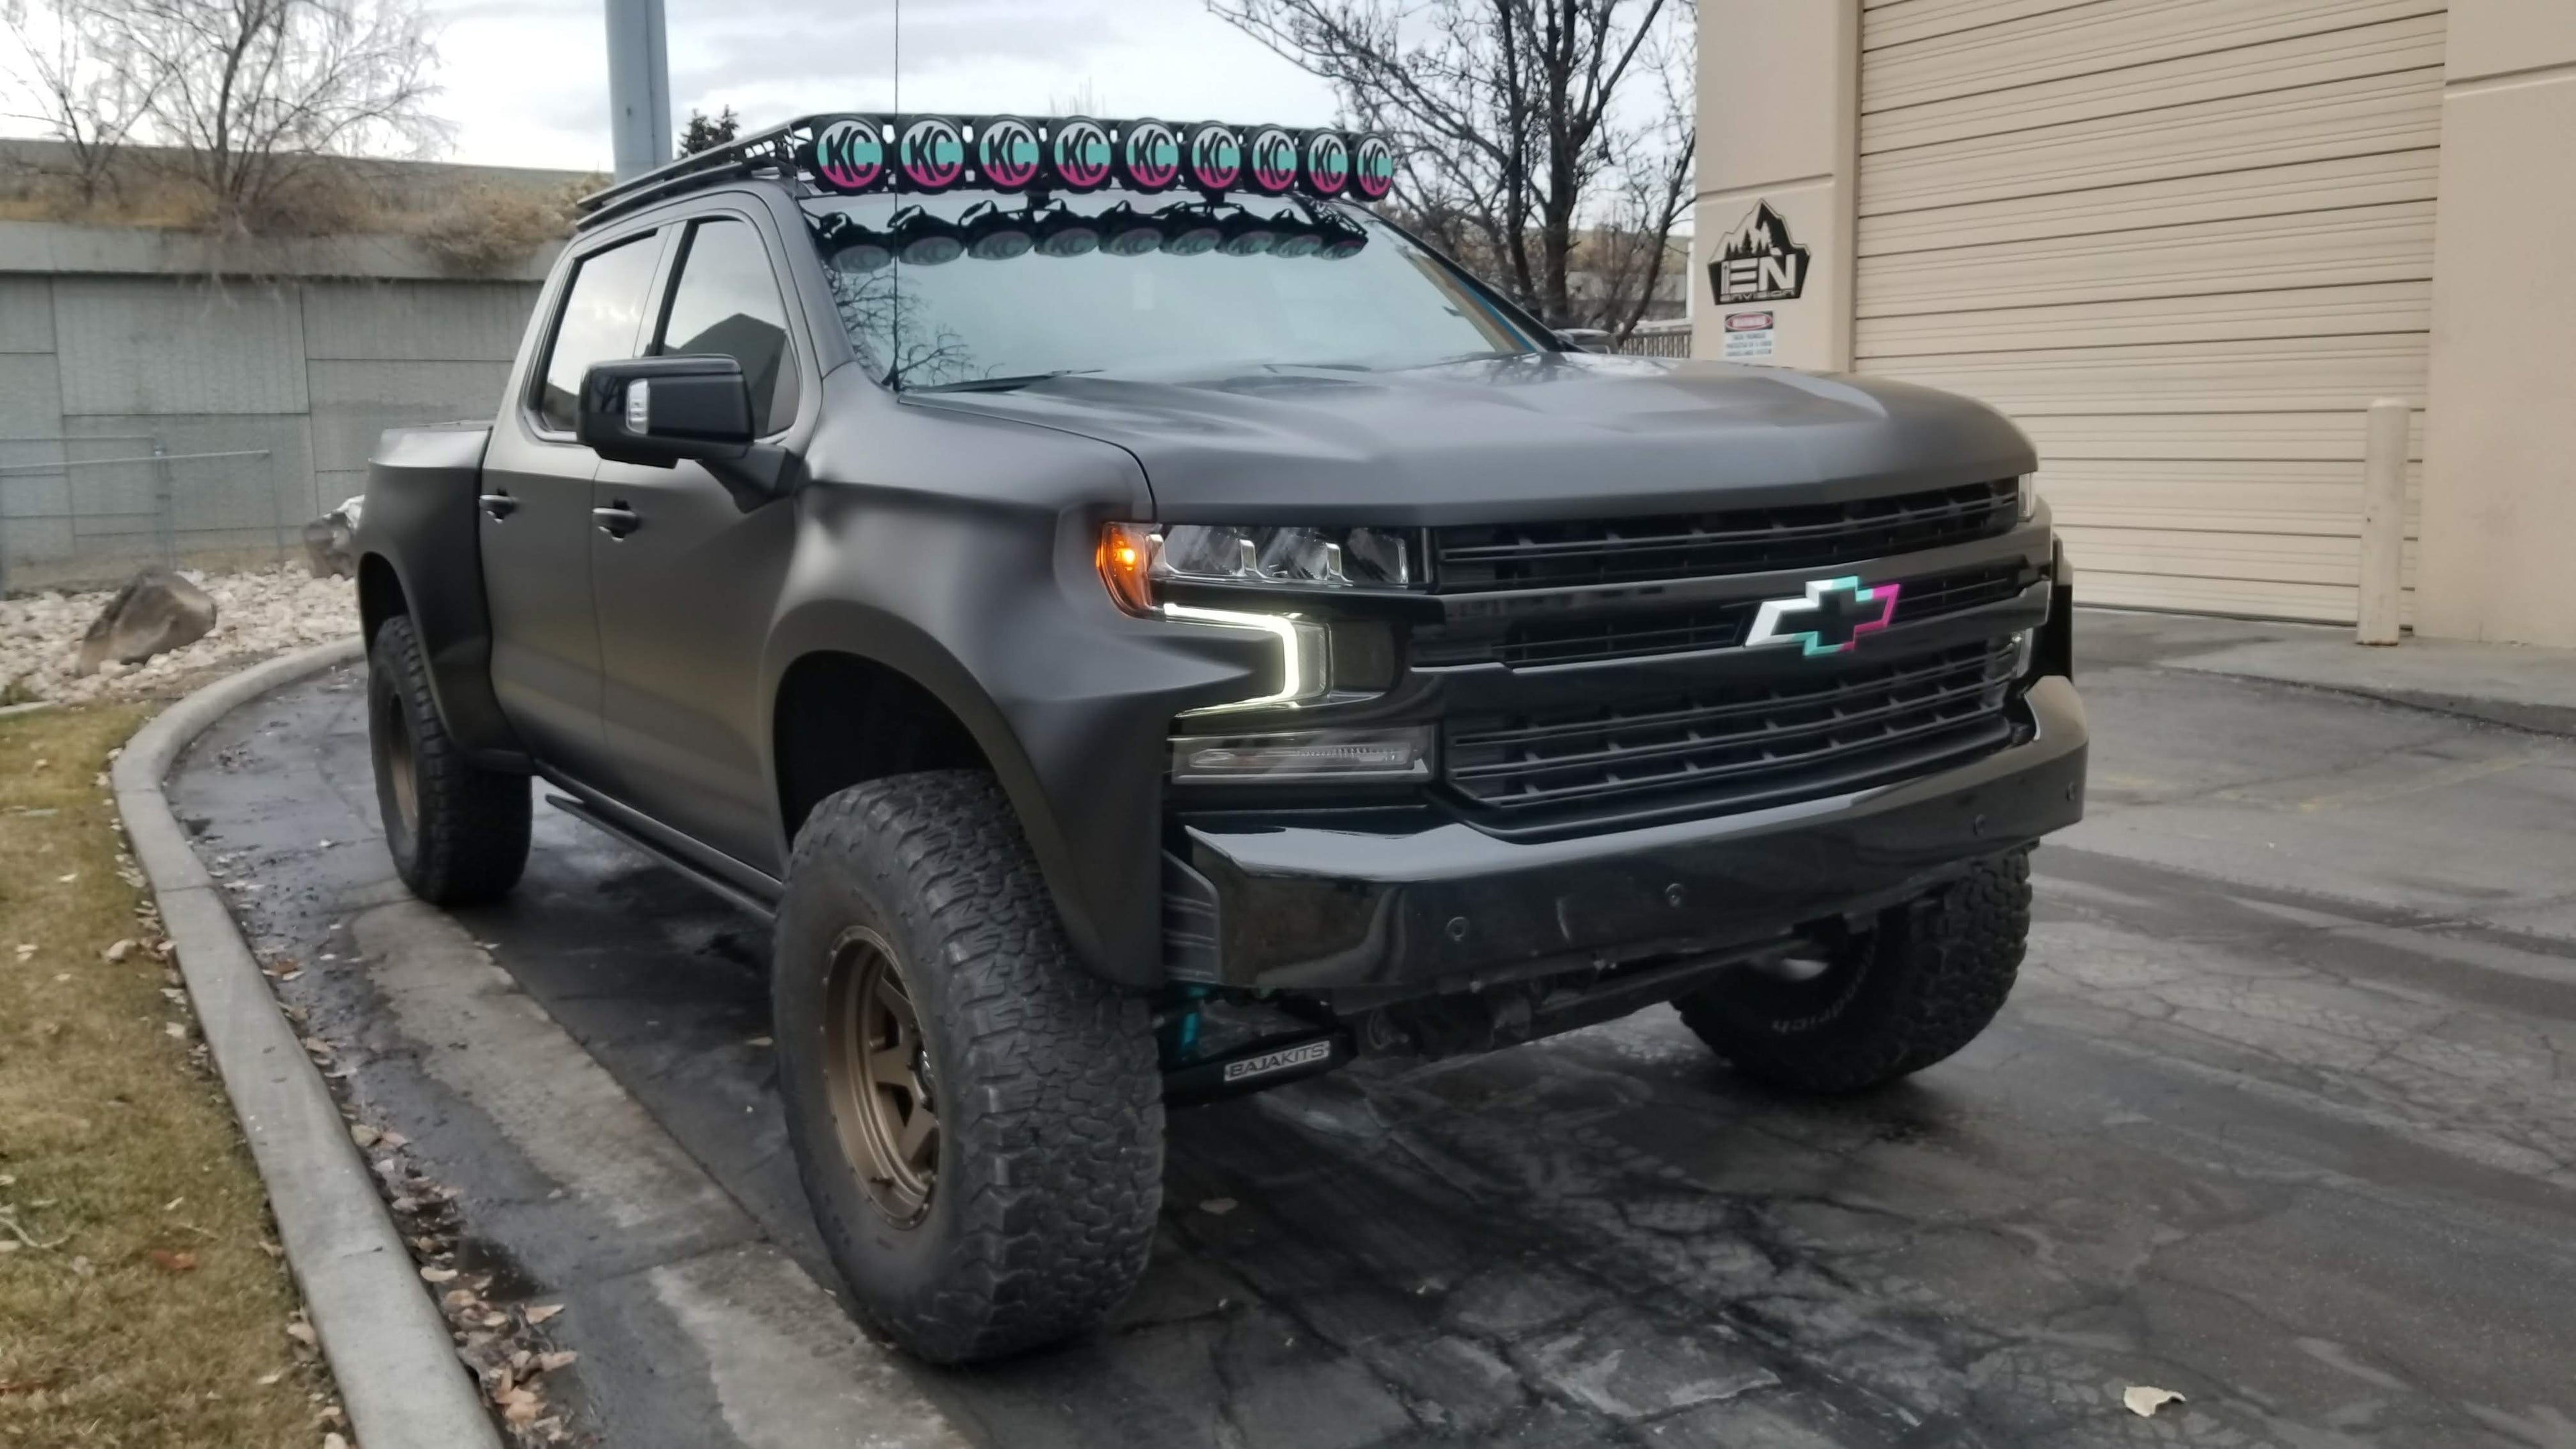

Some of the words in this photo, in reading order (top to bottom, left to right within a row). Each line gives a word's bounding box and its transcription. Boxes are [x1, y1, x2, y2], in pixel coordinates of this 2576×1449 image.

[826, 125, 873, 182] KC
[909, 125, 955, 181] KC
[987, 126, 1031, 181] KC
[1062, 127, 1102, 181] KC
[1134, 129, 1171, 182] KC
[1199, 131, 1234, 183] KC
[1260, 134, 1291, 184] KC
[1314, 136, 1342, 186] KC
[1362, 138, 1388, 191] KC
[1721, 254, 1796, 295] EN
[1228, 1043, 1325, 1078] BAJAKITS
